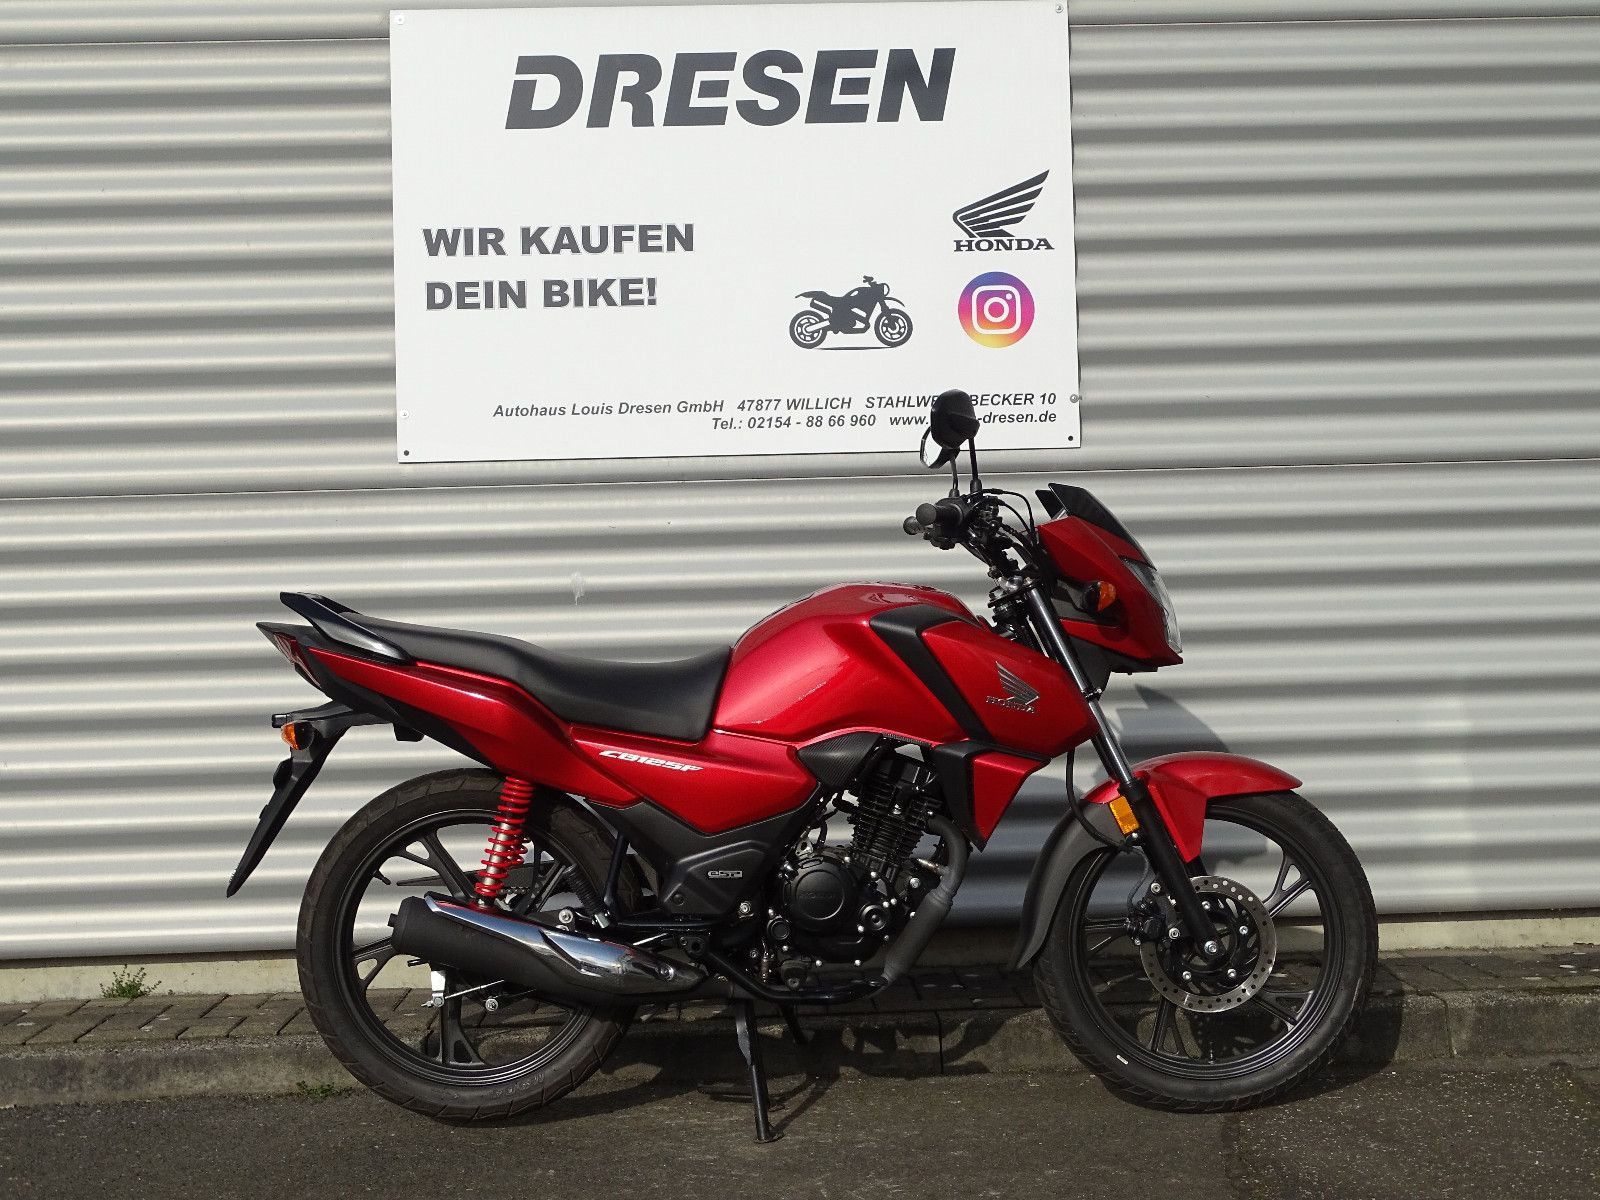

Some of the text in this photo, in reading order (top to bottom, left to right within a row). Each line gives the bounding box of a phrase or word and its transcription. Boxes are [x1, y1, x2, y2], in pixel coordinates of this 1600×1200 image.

[505, 48, 956, 129] DRESEN
[423, 224, 694, 256] WIR KAUFEN
[953, 237, 1054, 252] HONDA
[426, 278, 657, 310] DEIN BIKE!
[493, 404, 566, 417] Autohaus
[571, 402, 613, 415] Louis
[618, 402, 671, 415] Dresen
[677, 400, 724, 413] GmbH
[737, 399, 781, 412] 47877
[786, 397, 851, 410] WILLICH
[1040, 392, 1056, 405] 10
[712, 417, 742, 430] Tel.:
[747, 416, 791, 429] 02154
[806, 416, 823, 428] 88
[828, 415, 845, 428] 66
[850, 414, 876, 427] 960
[890, 411, 1057, 426] www.-dresen.de
